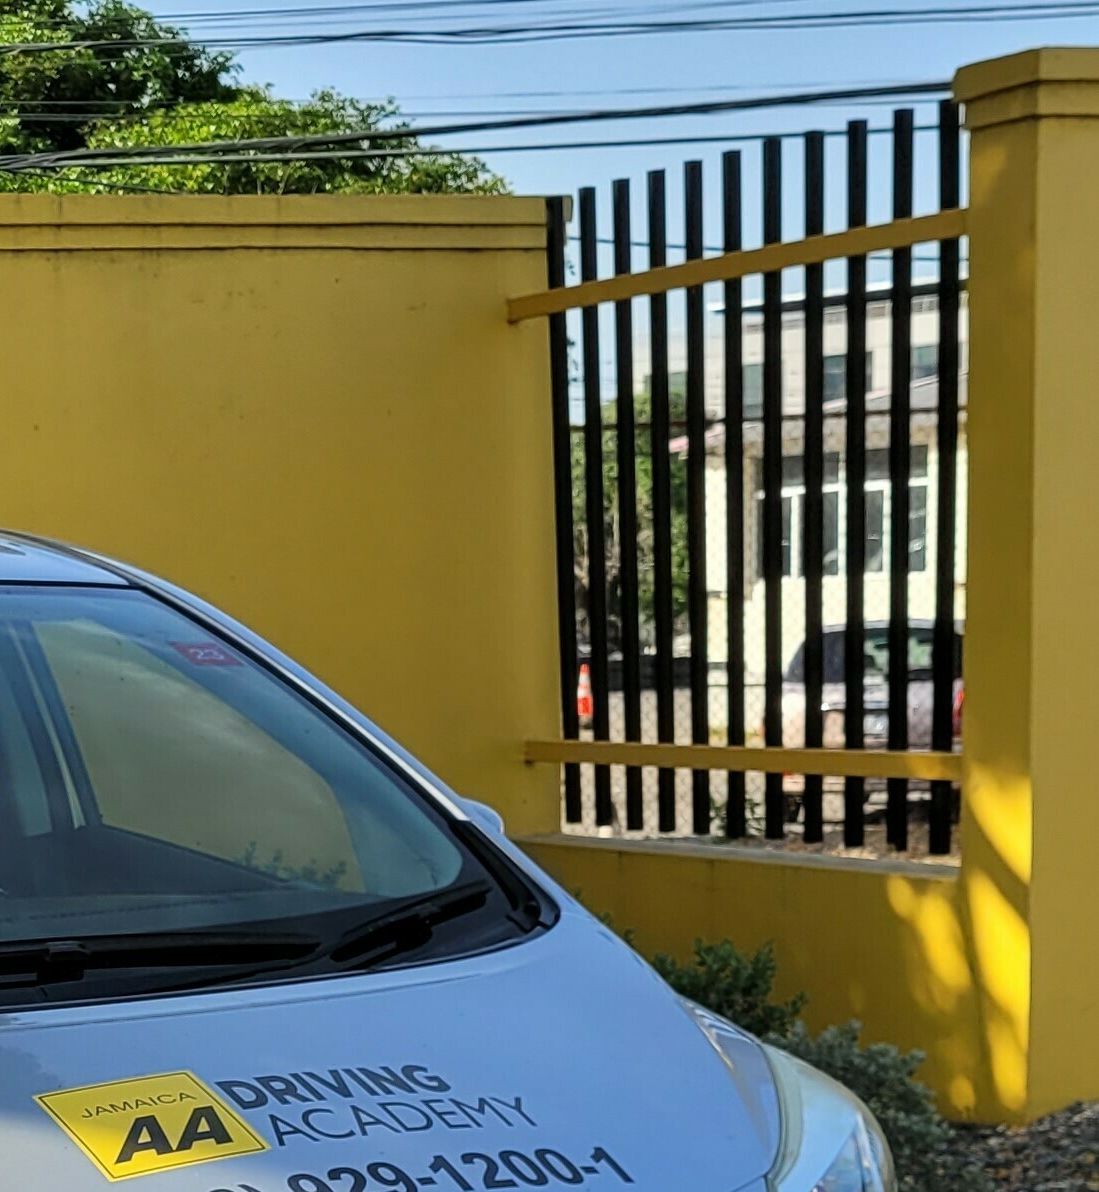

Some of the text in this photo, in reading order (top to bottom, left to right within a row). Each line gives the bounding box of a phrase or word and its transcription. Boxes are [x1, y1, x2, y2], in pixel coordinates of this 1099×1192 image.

[79, 1090, 198, 1120] JAMAICA
[215, 1064, 452, 1111] DRIVING
[114, 1105, 237, 1166] AA
[268, 1096, 538, 1147] ACADEMY
